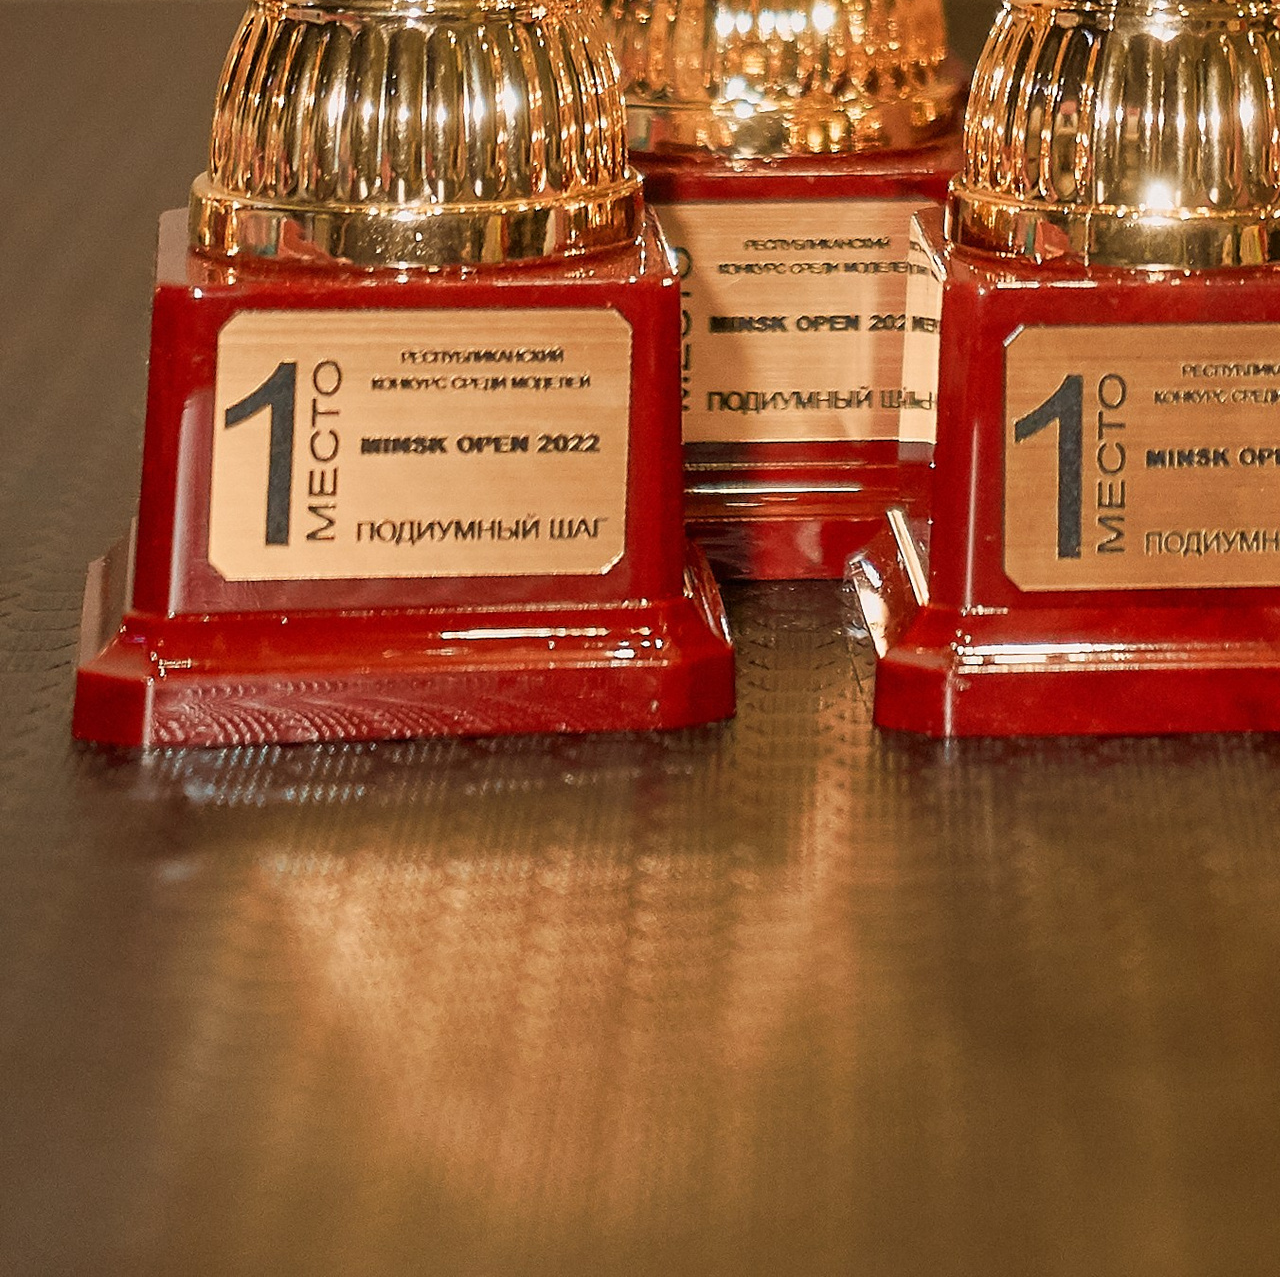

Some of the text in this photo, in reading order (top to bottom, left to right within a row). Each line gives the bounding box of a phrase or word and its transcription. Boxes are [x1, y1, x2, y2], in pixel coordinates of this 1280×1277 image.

[709, 315, 787, 334] MINSK
[796, 315, 861, 332] OPEN
[401, 348, 565, 363] РЕСПУБЛИКАНСКИЙ
[371, 373, 591, 390] КОНКУРС СРЕДИ МОДЕЛЕЙ
[706, 387, 873, 415] ПОДИУМНЫЙ
[1154, 389, 1226, 405] КОНКУРС
[224, 362, 297, 546] 1
[306, 359, 343, 542] МЕСТО
[361, 434, 600, 454] MINSK OPEN 2022
[1014, 374, 1084, 559] 1
[1097, 373, 1127, 554] МЕСТО
[1145, 449, 1229, 468] MINSK
[356, 514, 607, 545] ПОДИУМНЫЙ ШАГ
